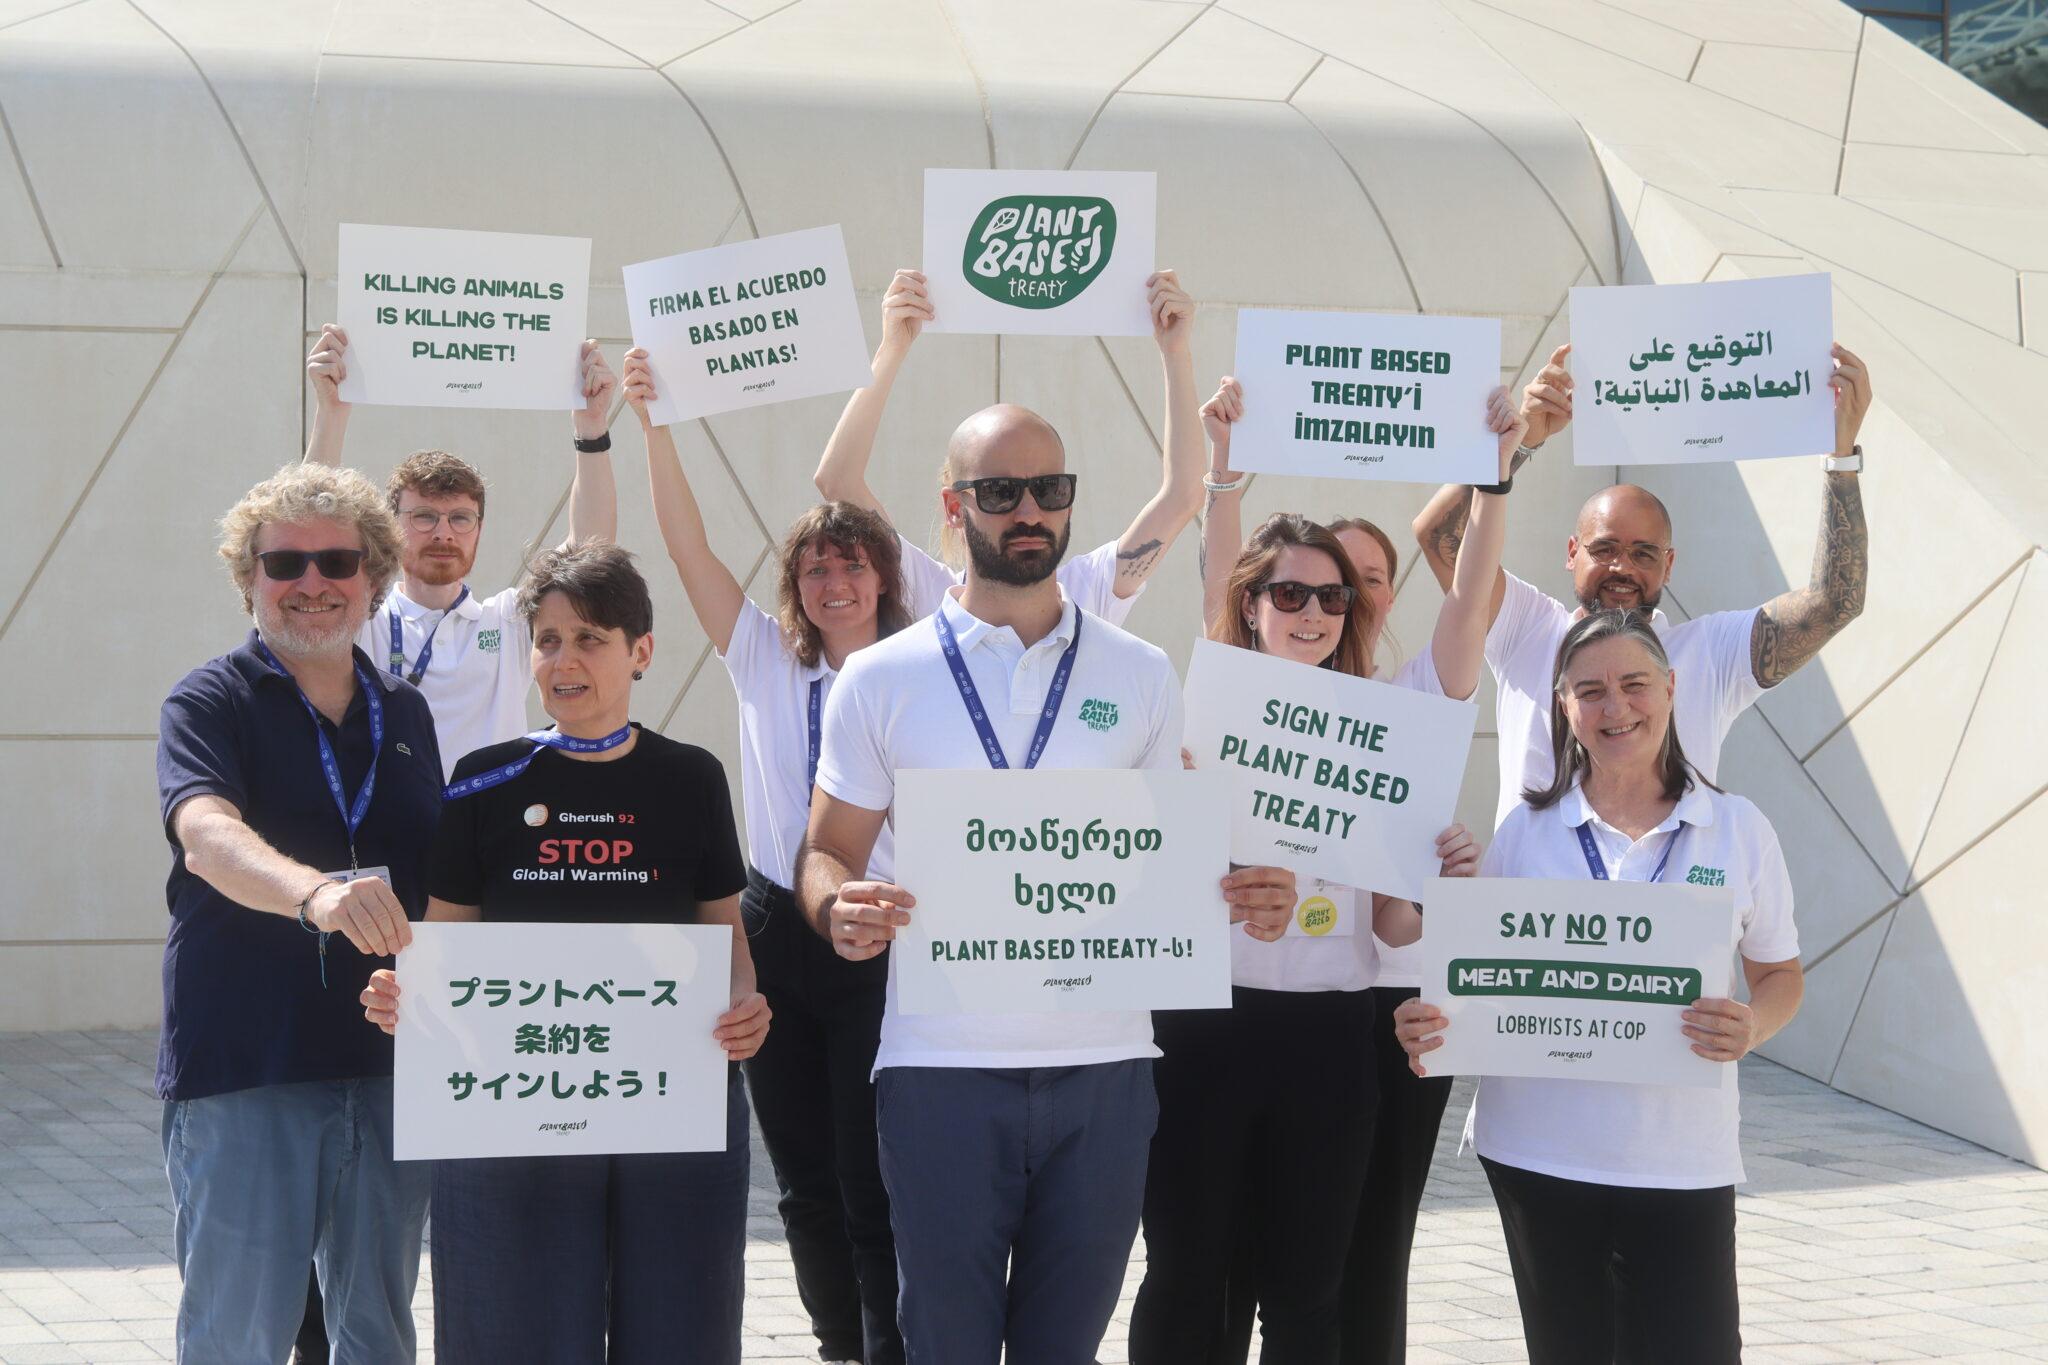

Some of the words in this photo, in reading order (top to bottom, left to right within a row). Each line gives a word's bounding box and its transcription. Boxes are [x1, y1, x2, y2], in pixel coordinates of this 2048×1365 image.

[981, 204, 1102, 243] PLANT
[973, 224, 1102, 277] BASED
[365, 273, 456, 294] KILLING
[464, 279, 563, 300] ANIMALS
[650, 291, 704, 317] FIRMA
[708, 286, 731, 306] EL
[737, 267, 826, 301] ACUERDO
[377, 307, 397, 324] IS
[406, 309, 495, 329] KILLING
[503, 313, 550, 331] THE
[689, 314, 767, 344] BASADO
[772, 308, 798, 329] EN
[413, 342, 514, 361] PLANET!
[706, 344, 797, 376] PLANTAS!
[1371, 349, 1450, 374] BASED
[1630, 337, 1675, 371] على
[1687, 330, 1772, 372] التوقيع
[1595, 378, 1689, 412] النباتية!
[1701, 370, 1810, 401] المعاهدة
[1078, 708, 1118, 726] BASED
[1081, 698, 1117, 712] PLANT
[1263, 699, 1329, 738] SIGN
[1337, 716, 1388, 752] THE
[1220, 735, 1309, 779] PLANT
[1314, 758, 1409, 804] BASED
[559, 813, 614, 822] Gherush
[619, 815, 634, 823] 92
[1253, 790, 1356, 839] TREATY
[539, 840, 633, 864] STOP
[967, 818, 1162, 860] მოაწერეთ
[513, 869, 564, 880] Global
[571, 869, 648, 883] Warming
[1688, 864, 1725, 877] PLANT
[1015, 873, 1115, 914] ხელი
[1500, 912, 1555, 938] SAY
[1564, 914, 1607, 942] NO
[1617, 916, 1652, 943] TO
[932, 940, 998, 961] PLANT
[1005, 939, 1075, 960] BASED
[450, 977, 678, 1007] プラントベース
[1459, 968, 1533, 986] MEAT
[1541, 970, 1599, 989] AND
[1607, 973, 1690, 995] DAIRY
[515, 1023, 610, 1054] 条約を
[1497, 1015, 1582, 1036] LOBBYISTS
[1588, 1020, 1608, 1038] AT
[1613, 1021, 1646, 1040] COP
